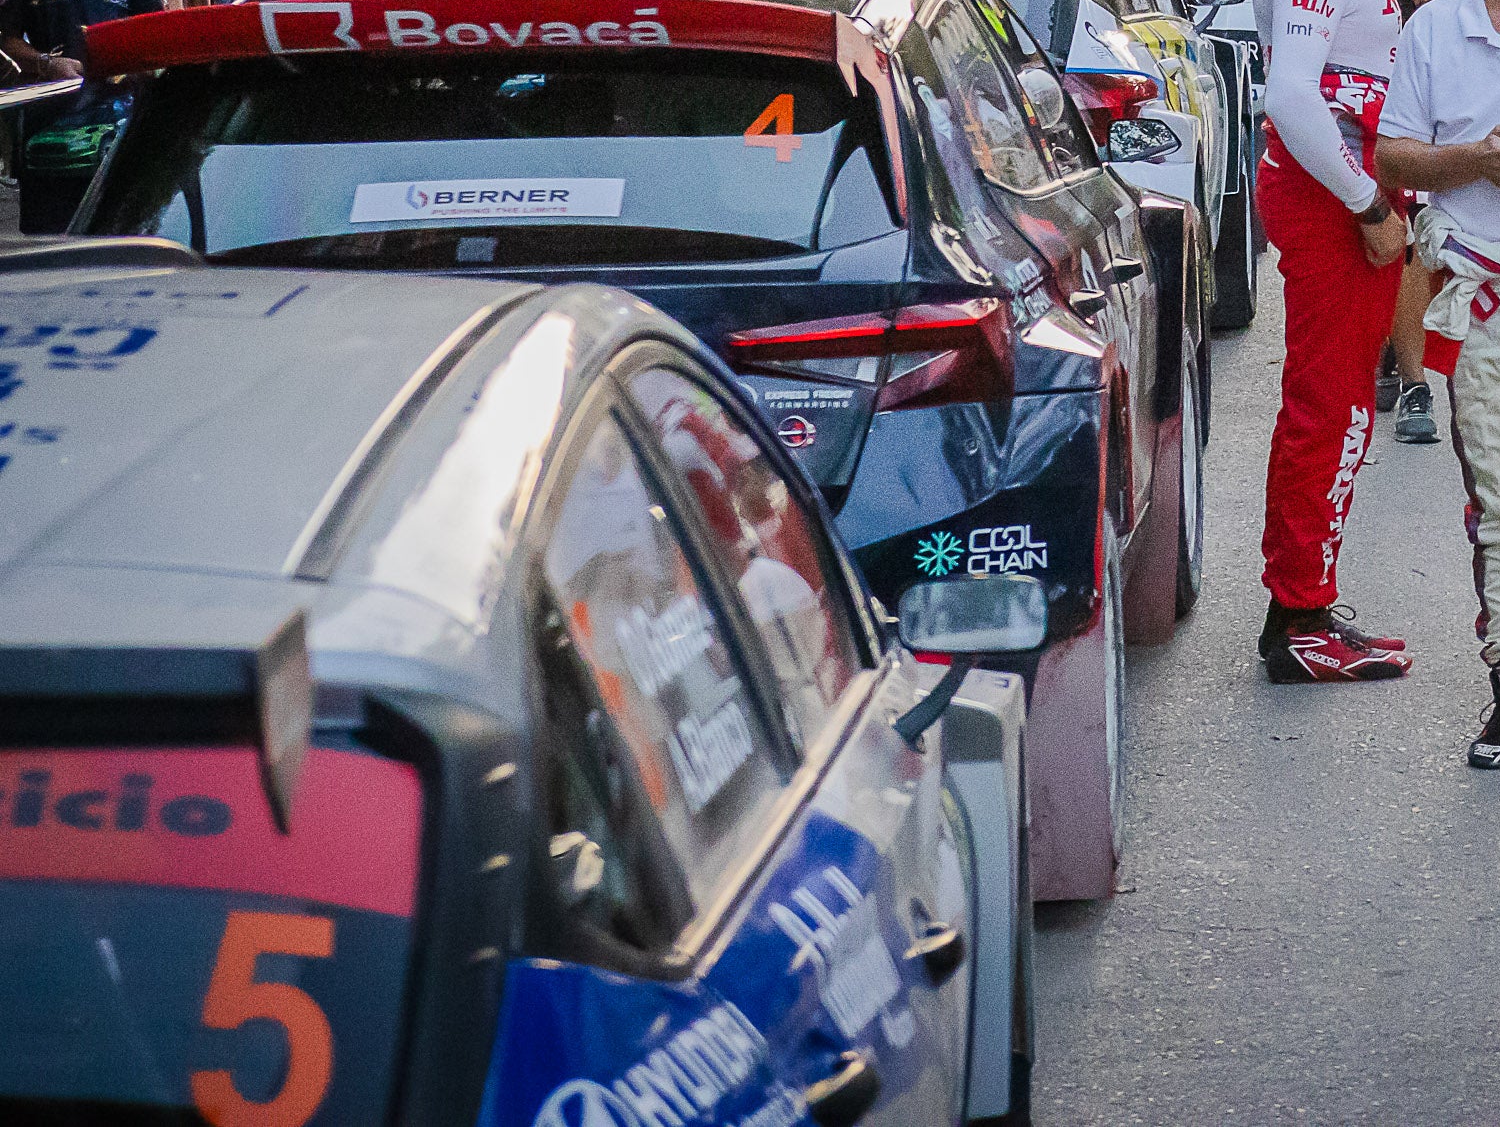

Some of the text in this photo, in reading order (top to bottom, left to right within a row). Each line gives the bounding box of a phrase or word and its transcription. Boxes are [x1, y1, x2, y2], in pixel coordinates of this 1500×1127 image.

[743, 93, 802, 163] 4
[433, 189, 570, 206] BERNER
[968, 524, 1047, 554] COOL
[967, 549, 1048, 574] CHAIN
[190, 908, 335, 1127] 5
